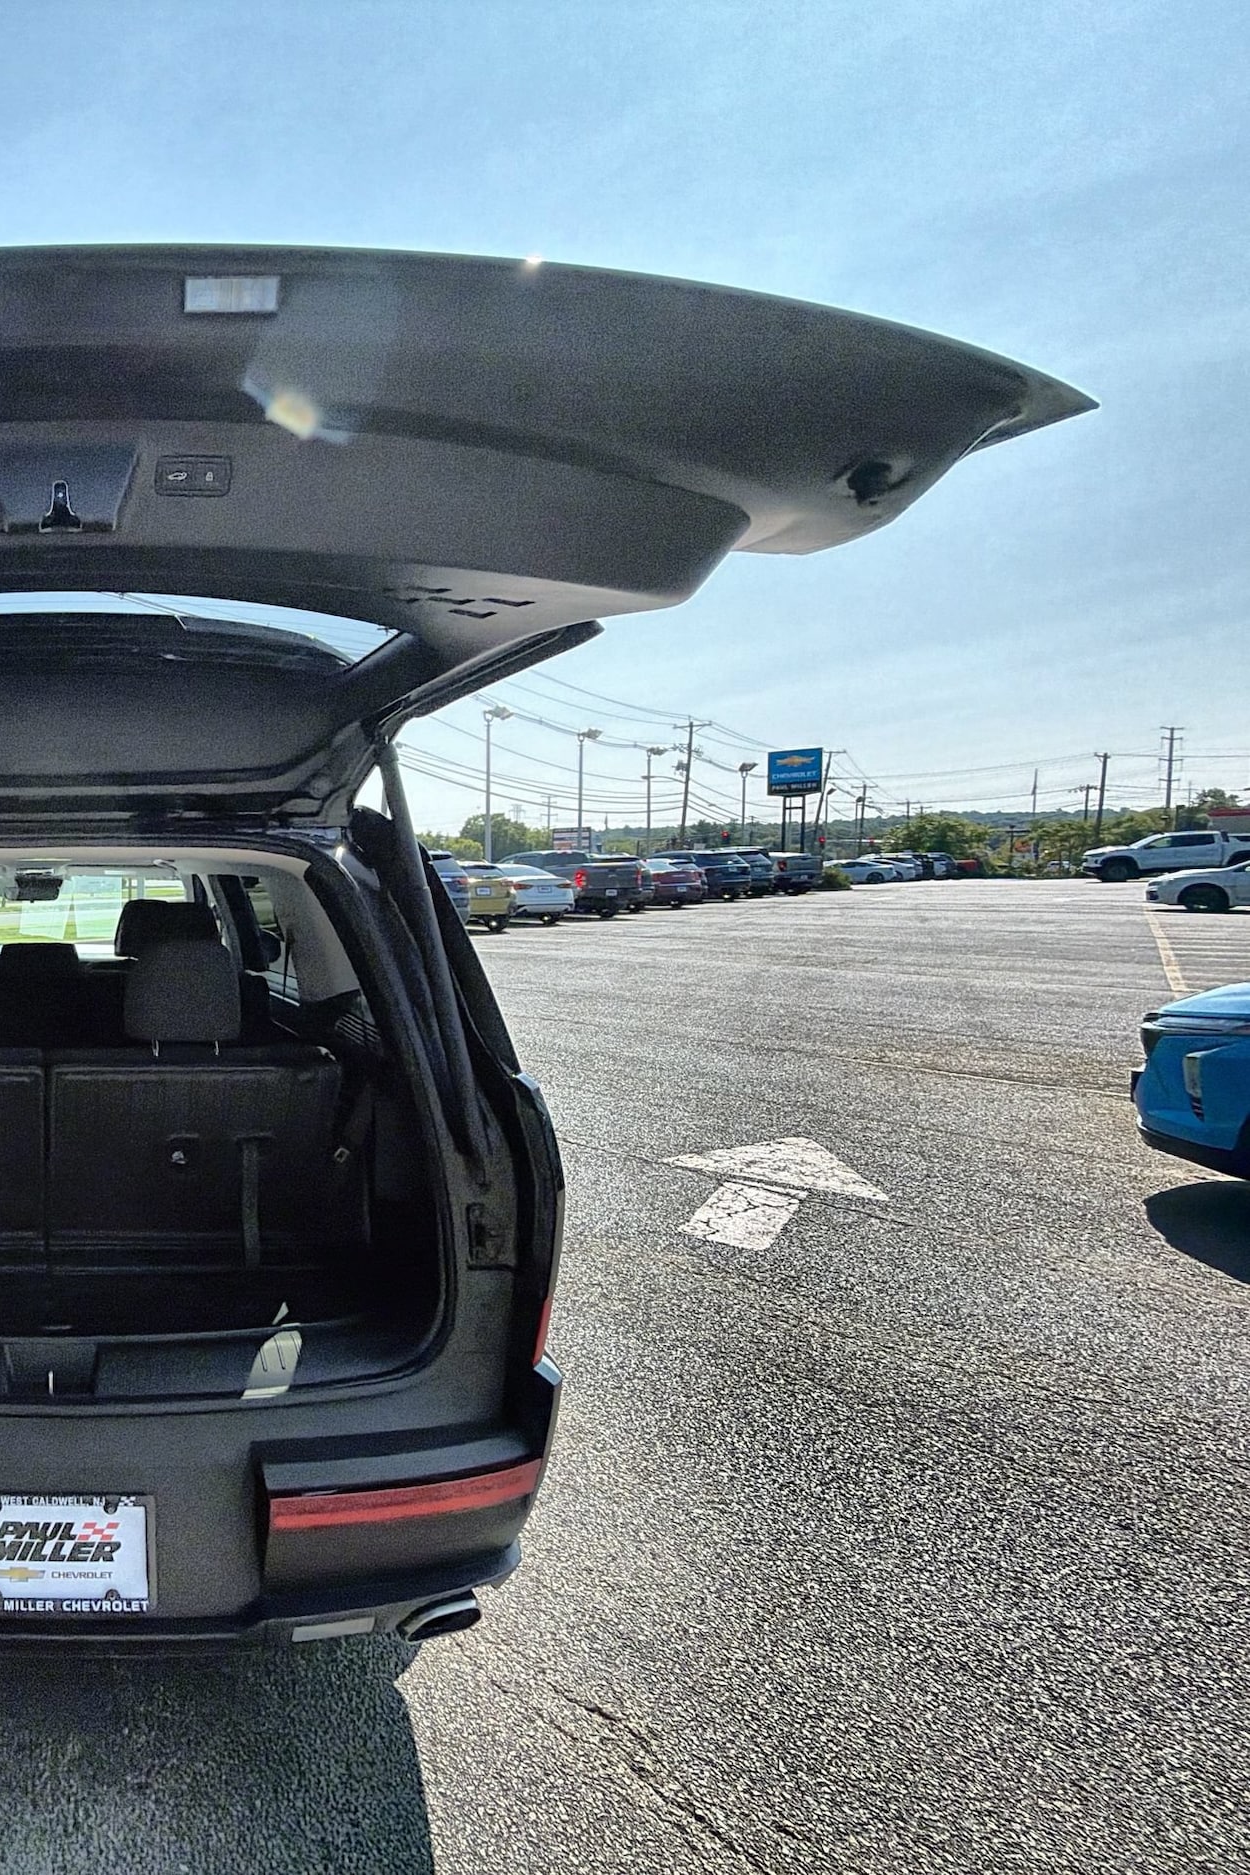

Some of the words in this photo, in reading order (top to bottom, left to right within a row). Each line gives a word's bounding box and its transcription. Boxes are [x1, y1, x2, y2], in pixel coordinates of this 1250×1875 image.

[0, 1496, 28, 1506] WEST
[51, 1571, 113, 1579] CHEVROLET
[4, 1600, 54, 1611] MILLER
[62, 1600, 149, 1612] CHEVROLET
